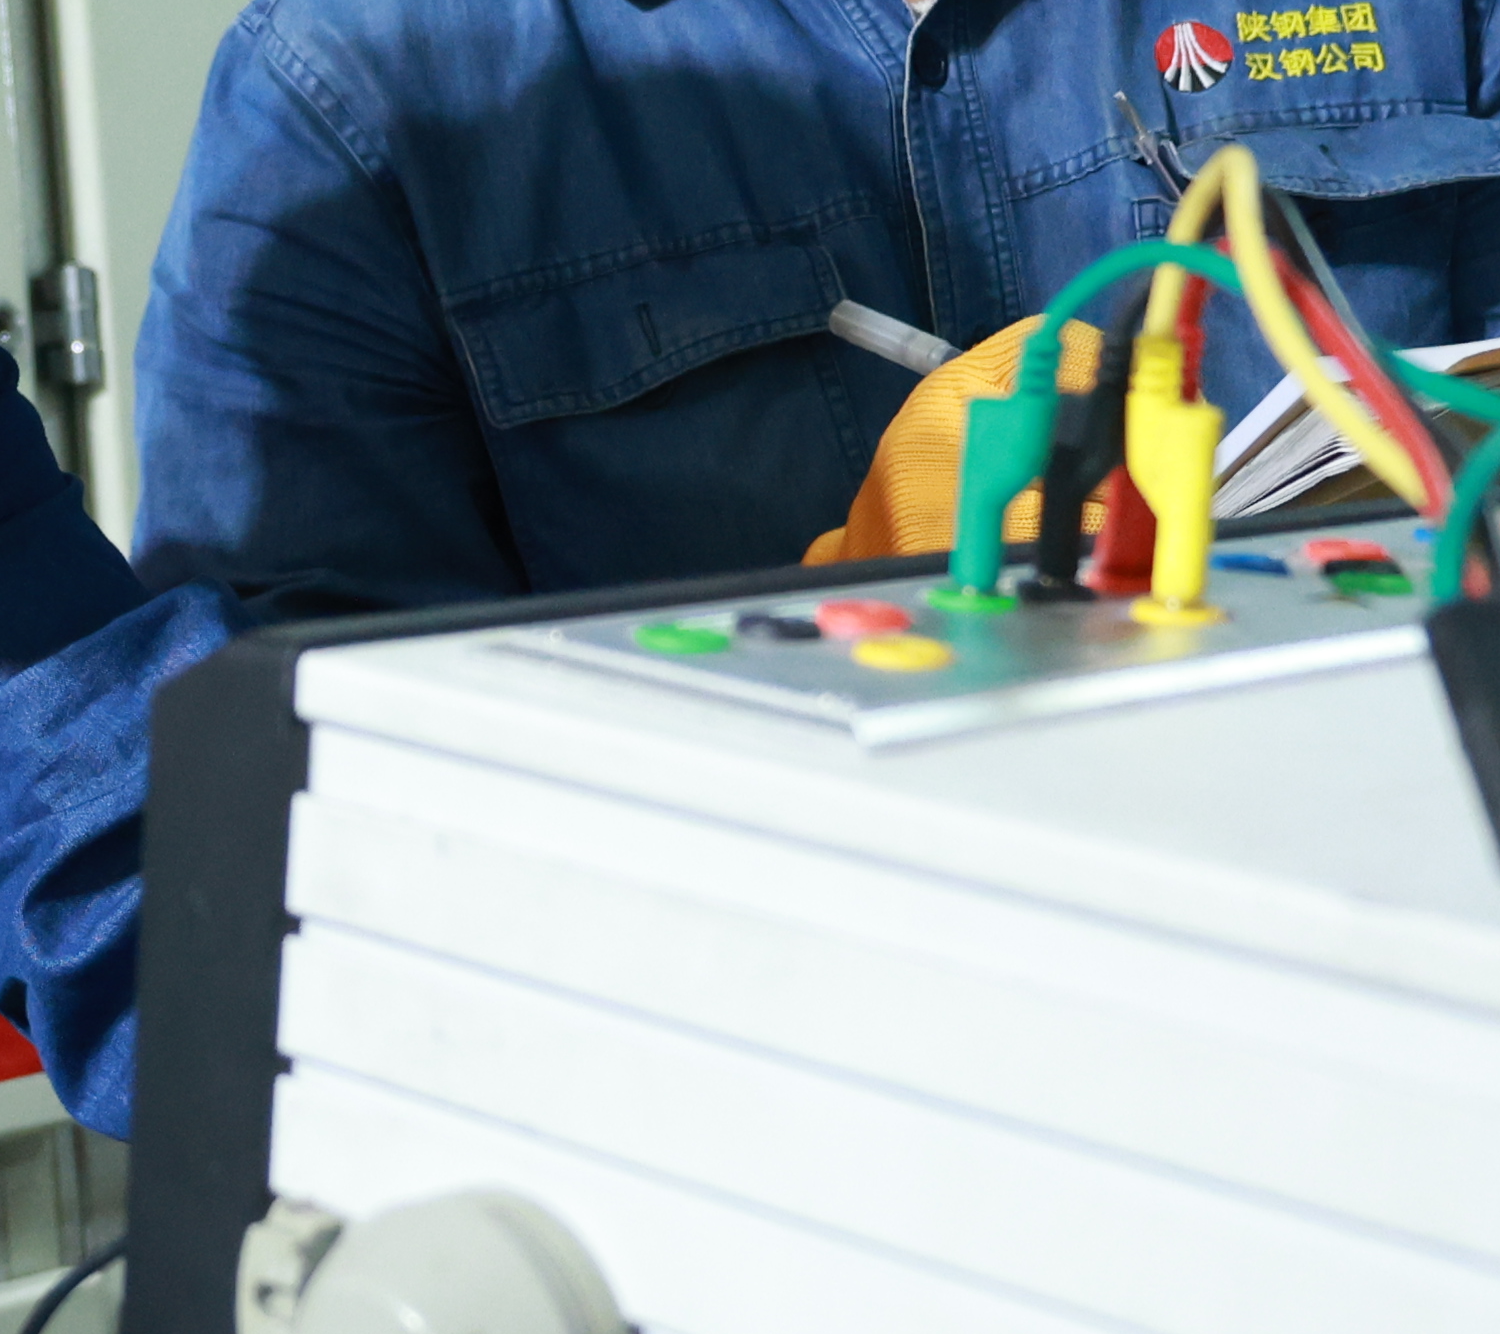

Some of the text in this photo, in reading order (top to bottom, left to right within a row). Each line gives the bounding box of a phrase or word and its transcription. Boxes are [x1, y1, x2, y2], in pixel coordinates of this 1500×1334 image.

[1236, 1, 1378, 44] 陕钢集团
[1245, 42, 1385, 81] 汉钢公司
